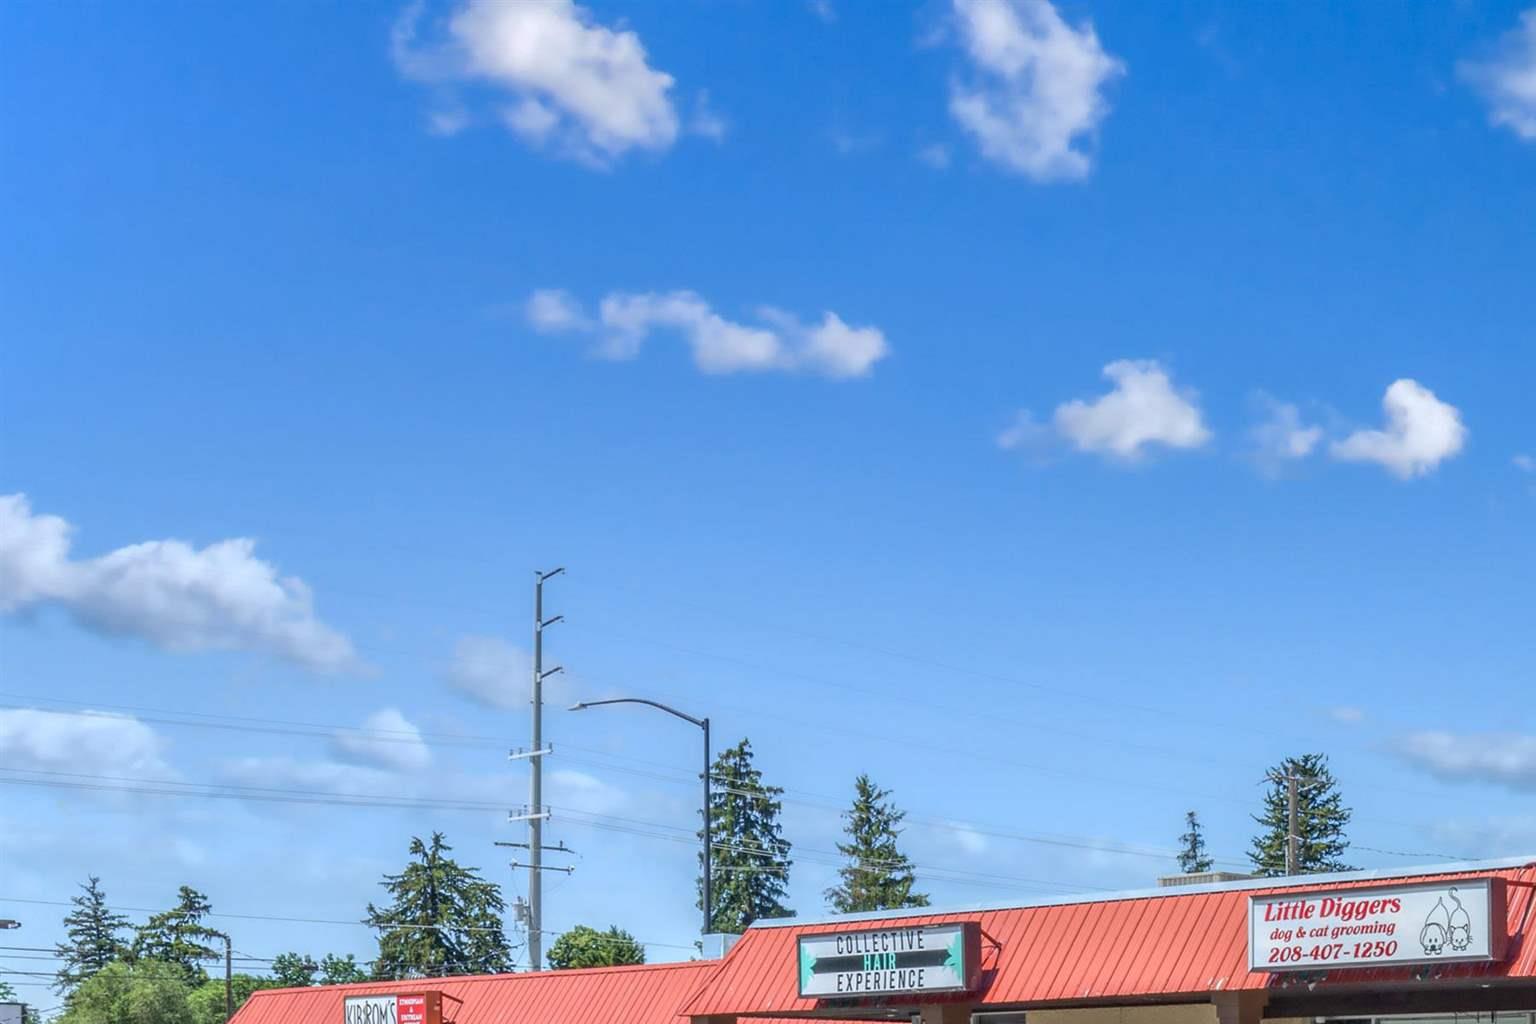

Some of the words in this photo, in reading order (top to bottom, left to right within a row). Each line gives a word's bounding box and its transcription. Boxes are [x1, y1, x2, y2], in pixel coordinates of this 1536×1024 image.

[1264, 899, 1315, 922] Little
[1319, 897, 1401, 921] Diggers
[837, 930, 925, 954] COLLECTIVE
[1270, 927, 1293, 942] dog
[1296, 926, 1307, 938] &
[1309, 924, 1329, 938] cat
[1331, 921, 1396, 938] grooming
[863, 952, 897, 971] HAIR
[1268, 940, 1398, 963] 208-407-1250
[836, 969, 925, 992] EXPERIENCE
